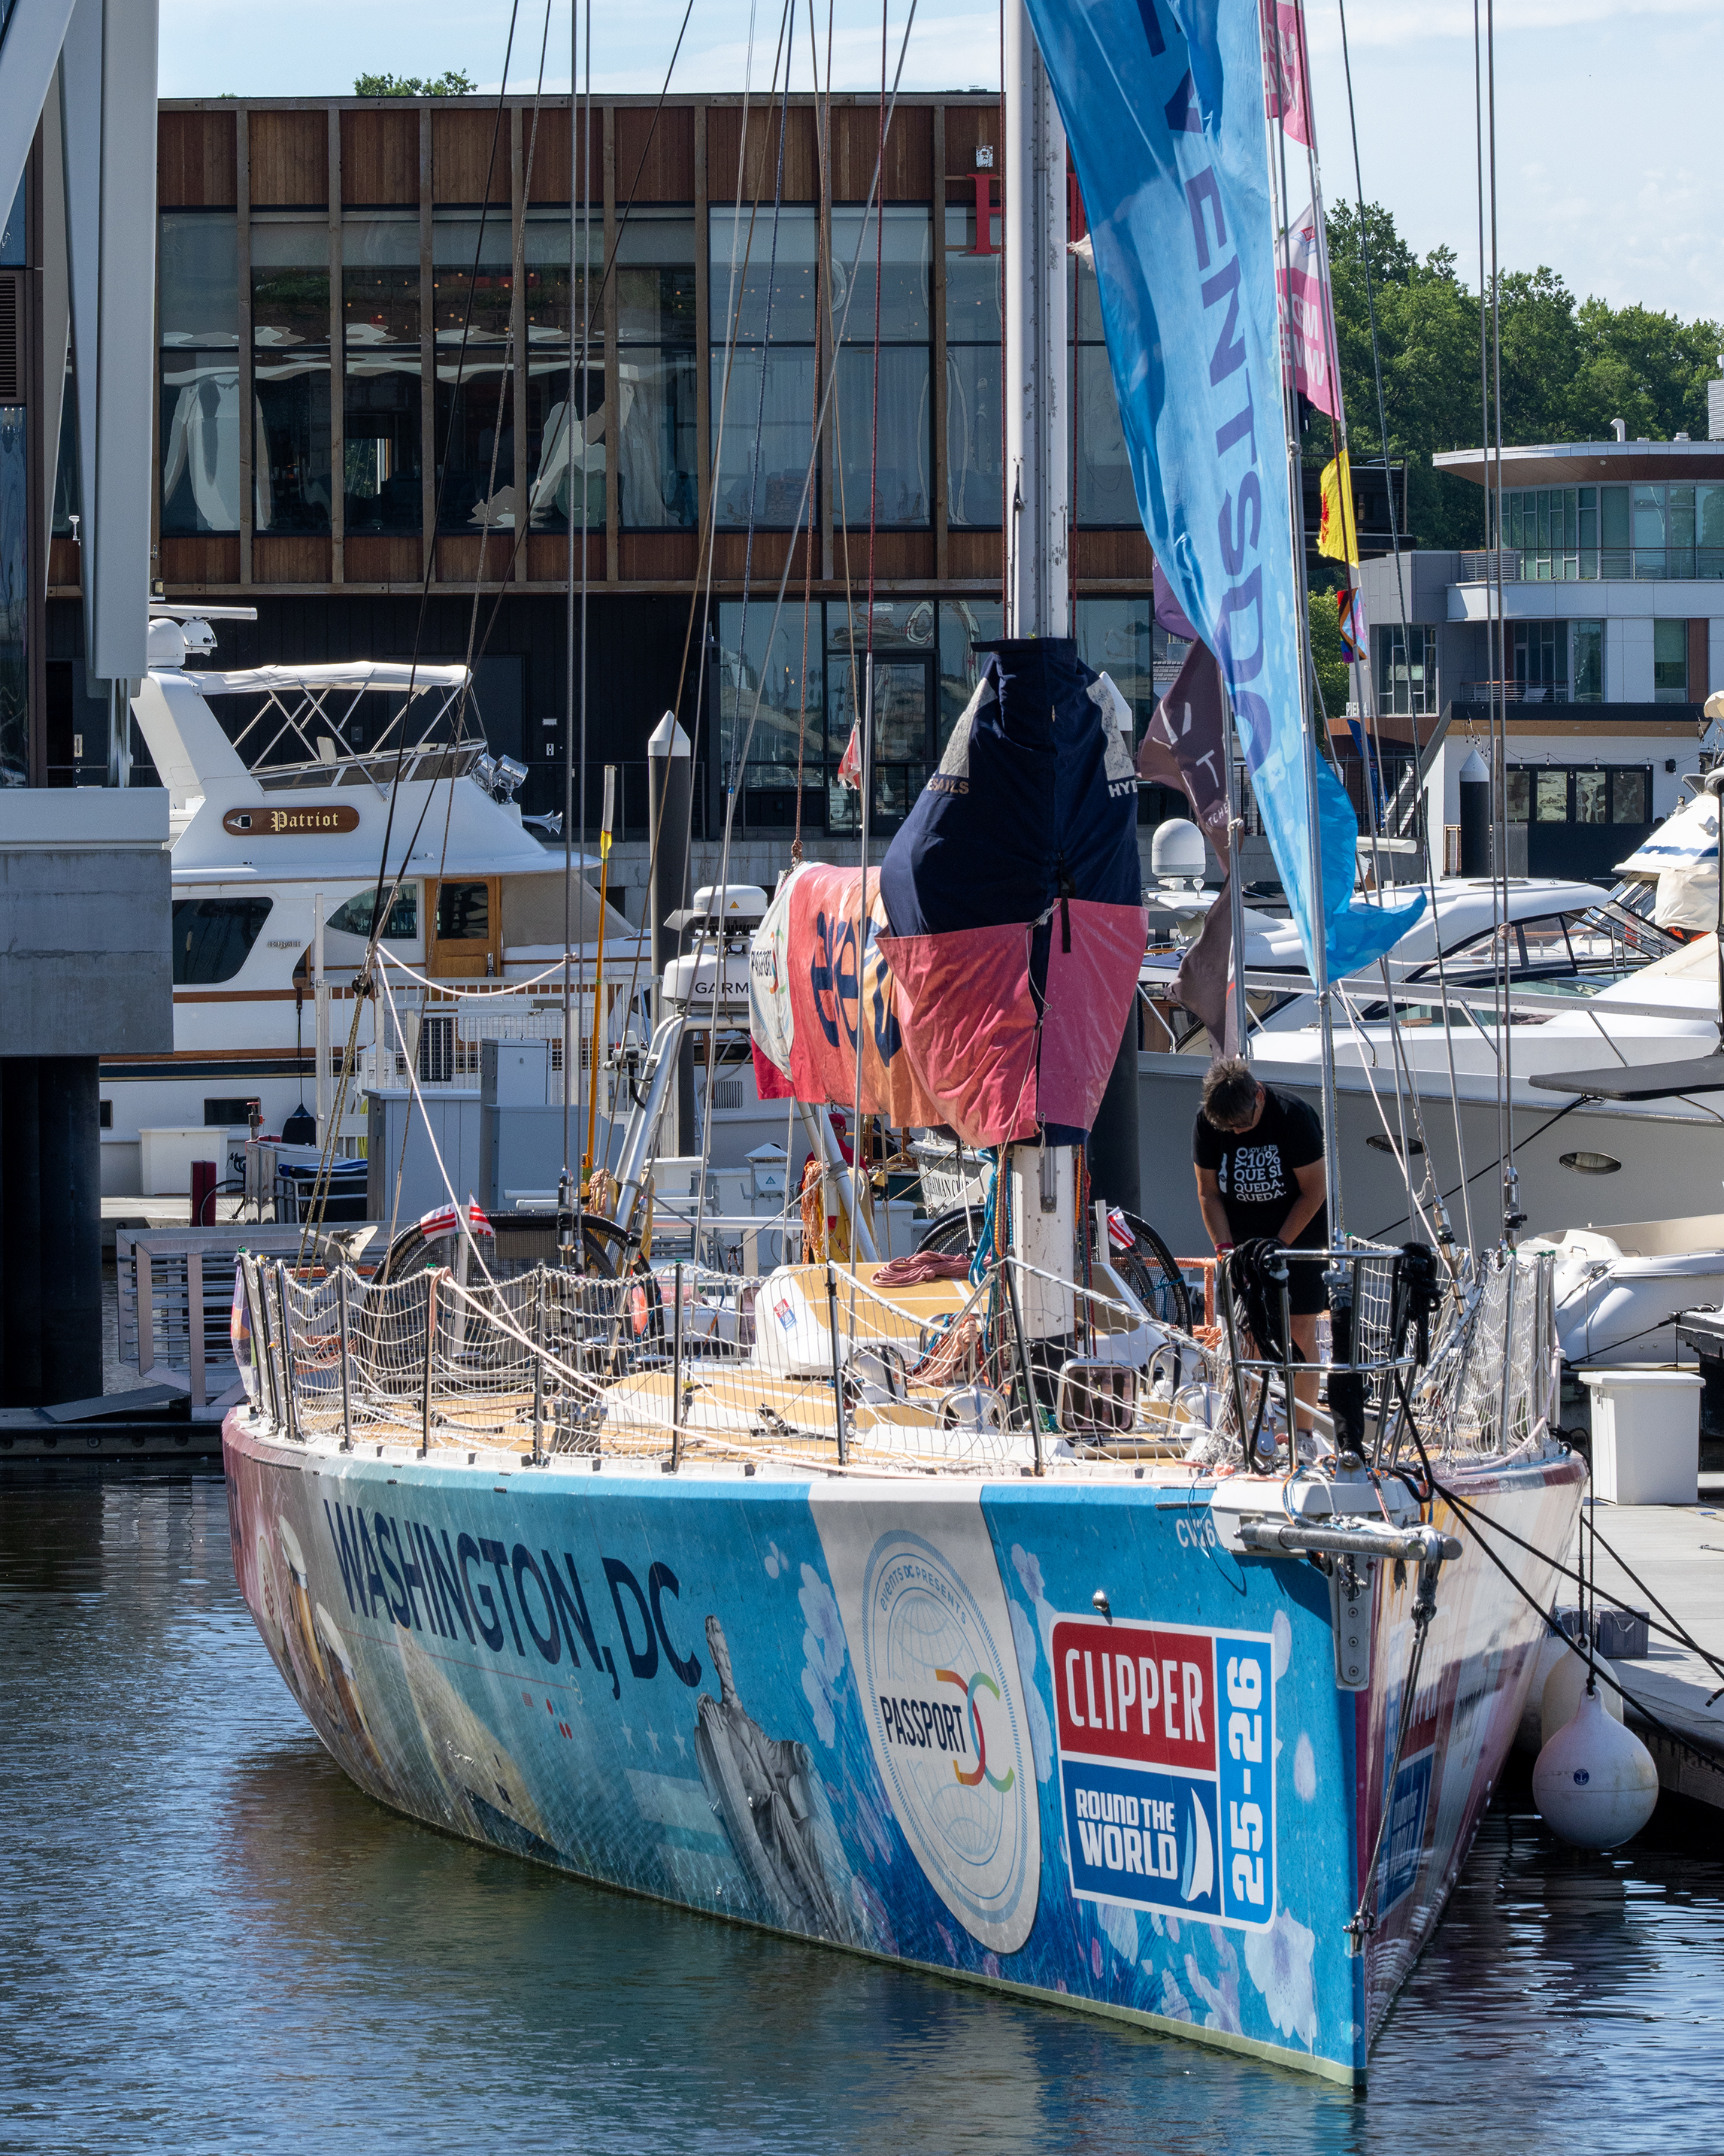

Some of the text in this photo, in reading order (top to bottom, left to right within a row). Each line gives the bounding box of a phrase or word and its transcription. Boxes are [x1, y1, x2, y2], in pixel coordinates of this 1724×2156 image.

[270, 811, 339, 832] Patriot
[1233, 1168, 1266, 1184] QUE
[1247, 1150, 1281, 1169] 10%
[1234, 1178, 1284, 1194] QUEDA,
[1236, 1189, 1287, 1202] QUEDA.
[323, 1499, 621, 1701] WASHINGTON,
[601, 1557, 703, 1688] DC
[915, 1566, 968, 1625] PRESENTS
[1065, 1648, 1206, 1743] CLIPPER
[878, 1695, 968, 1754] PASSPORT
[1226, 1656, 1265, 1906] 25-26
[1074, 1788, 1177, 1833] ROUND THE
[1077, 1820, 1179, 1881] WORLD
